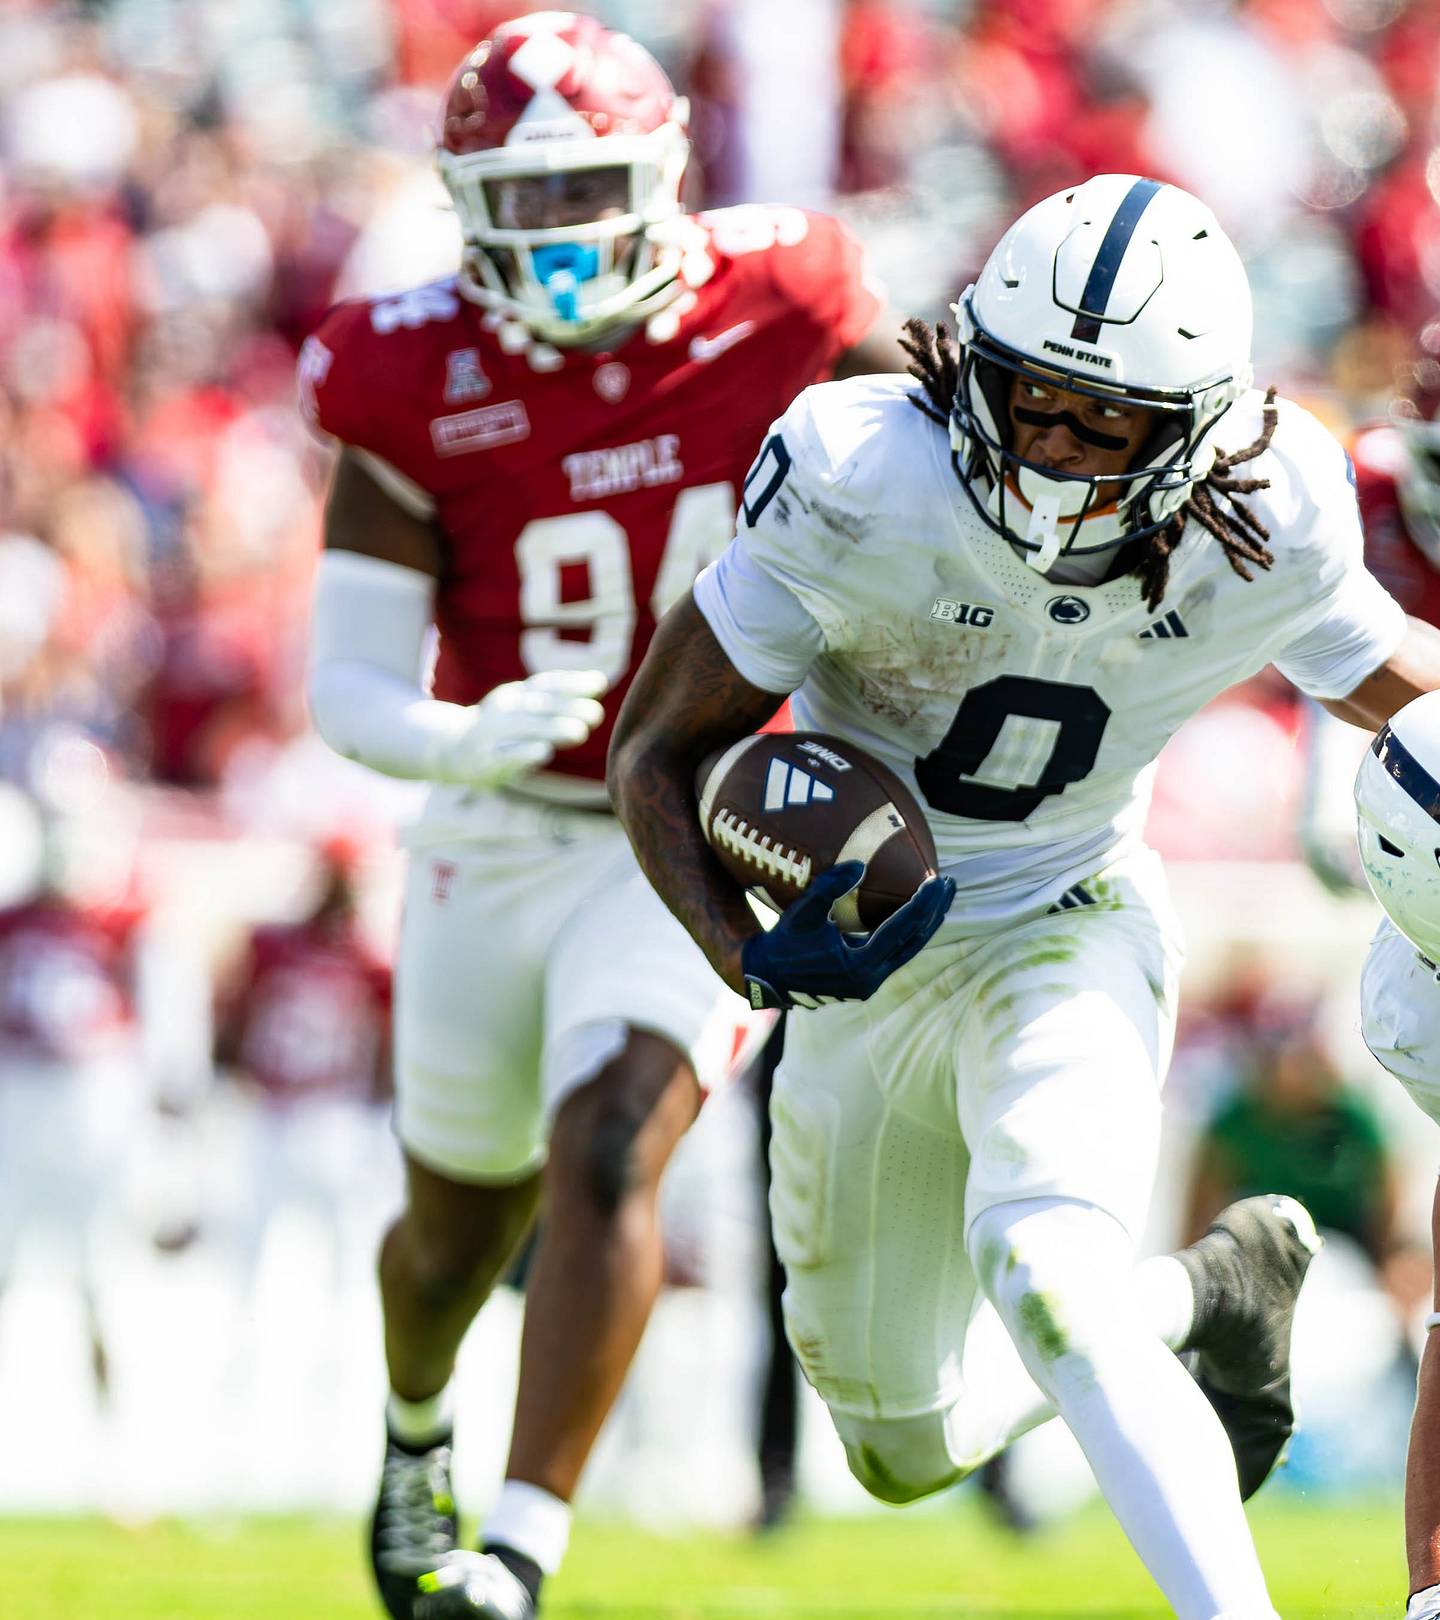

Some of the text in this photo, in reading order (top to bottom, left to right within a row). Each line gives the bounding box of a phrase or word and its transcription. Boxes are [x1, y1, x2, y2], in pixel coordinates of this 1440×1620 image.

[1043, 340, 1112, 368] PENN STATE
[562, 434, 684, 501] TEMPLE
[796, 740, 853, 772] DIME
[915, 675, 1112, 822] 0
